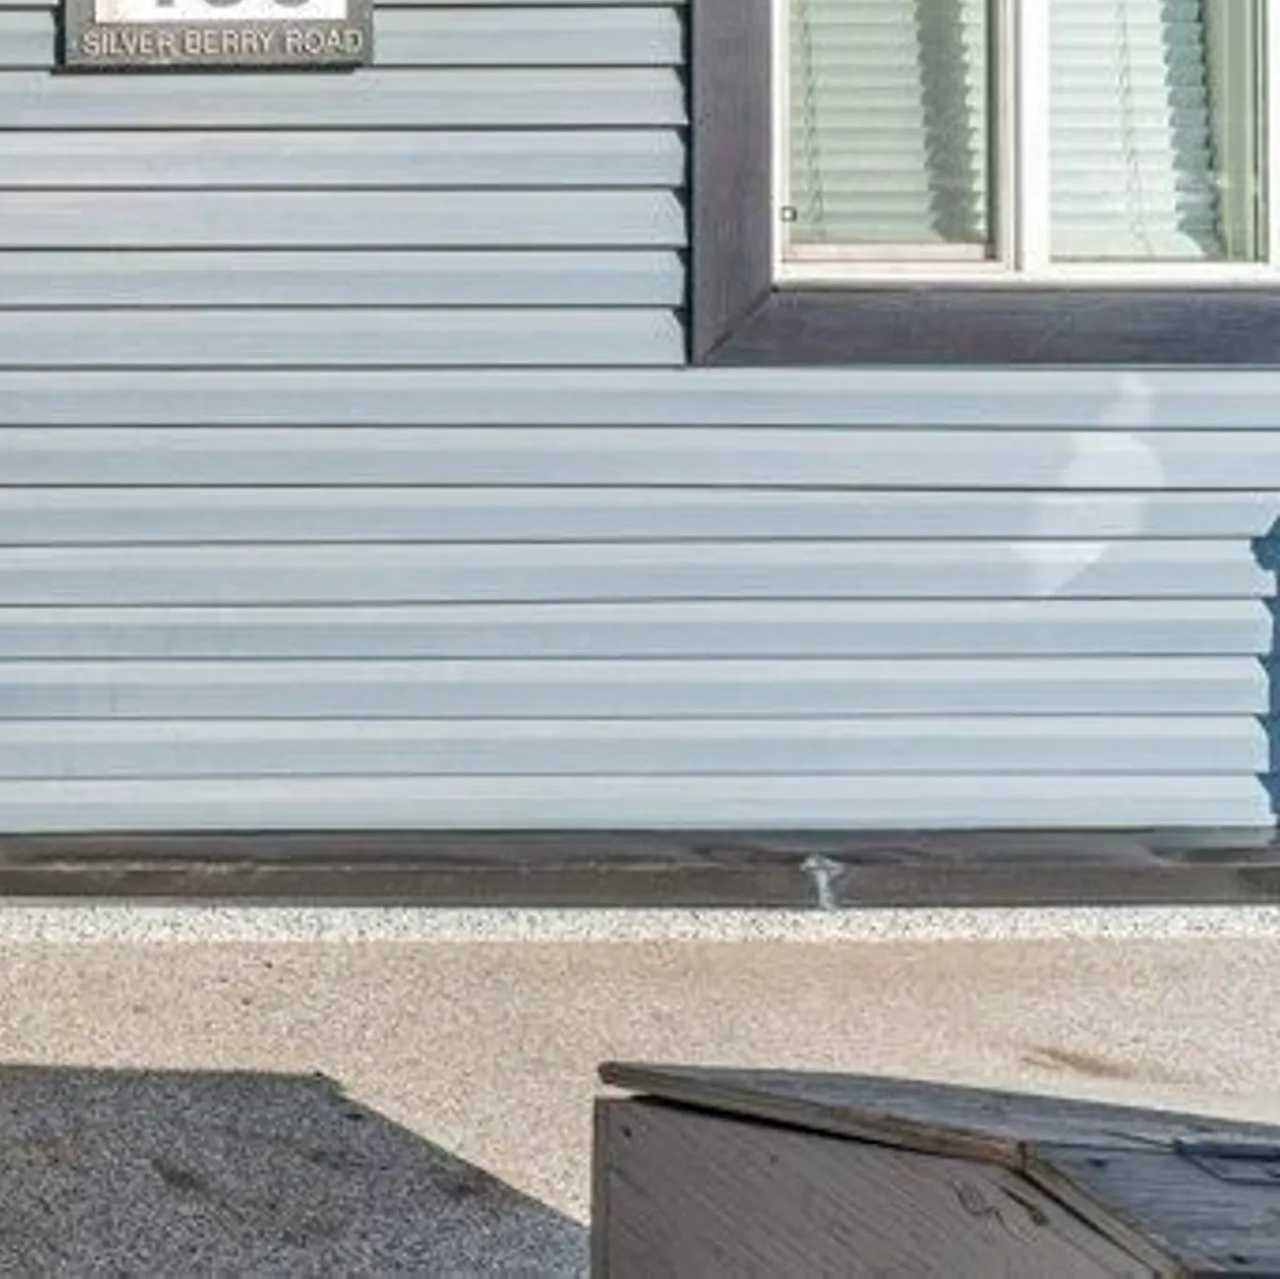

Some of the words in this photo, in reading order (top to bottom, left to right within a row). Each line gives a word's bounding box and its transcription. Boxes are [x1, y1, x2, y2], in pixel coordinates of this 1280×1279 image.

[82, 29, 179, 55] SILVER
[184, 29, 276, 54] BERRY
[287, 29, 362, 54] ROAD
